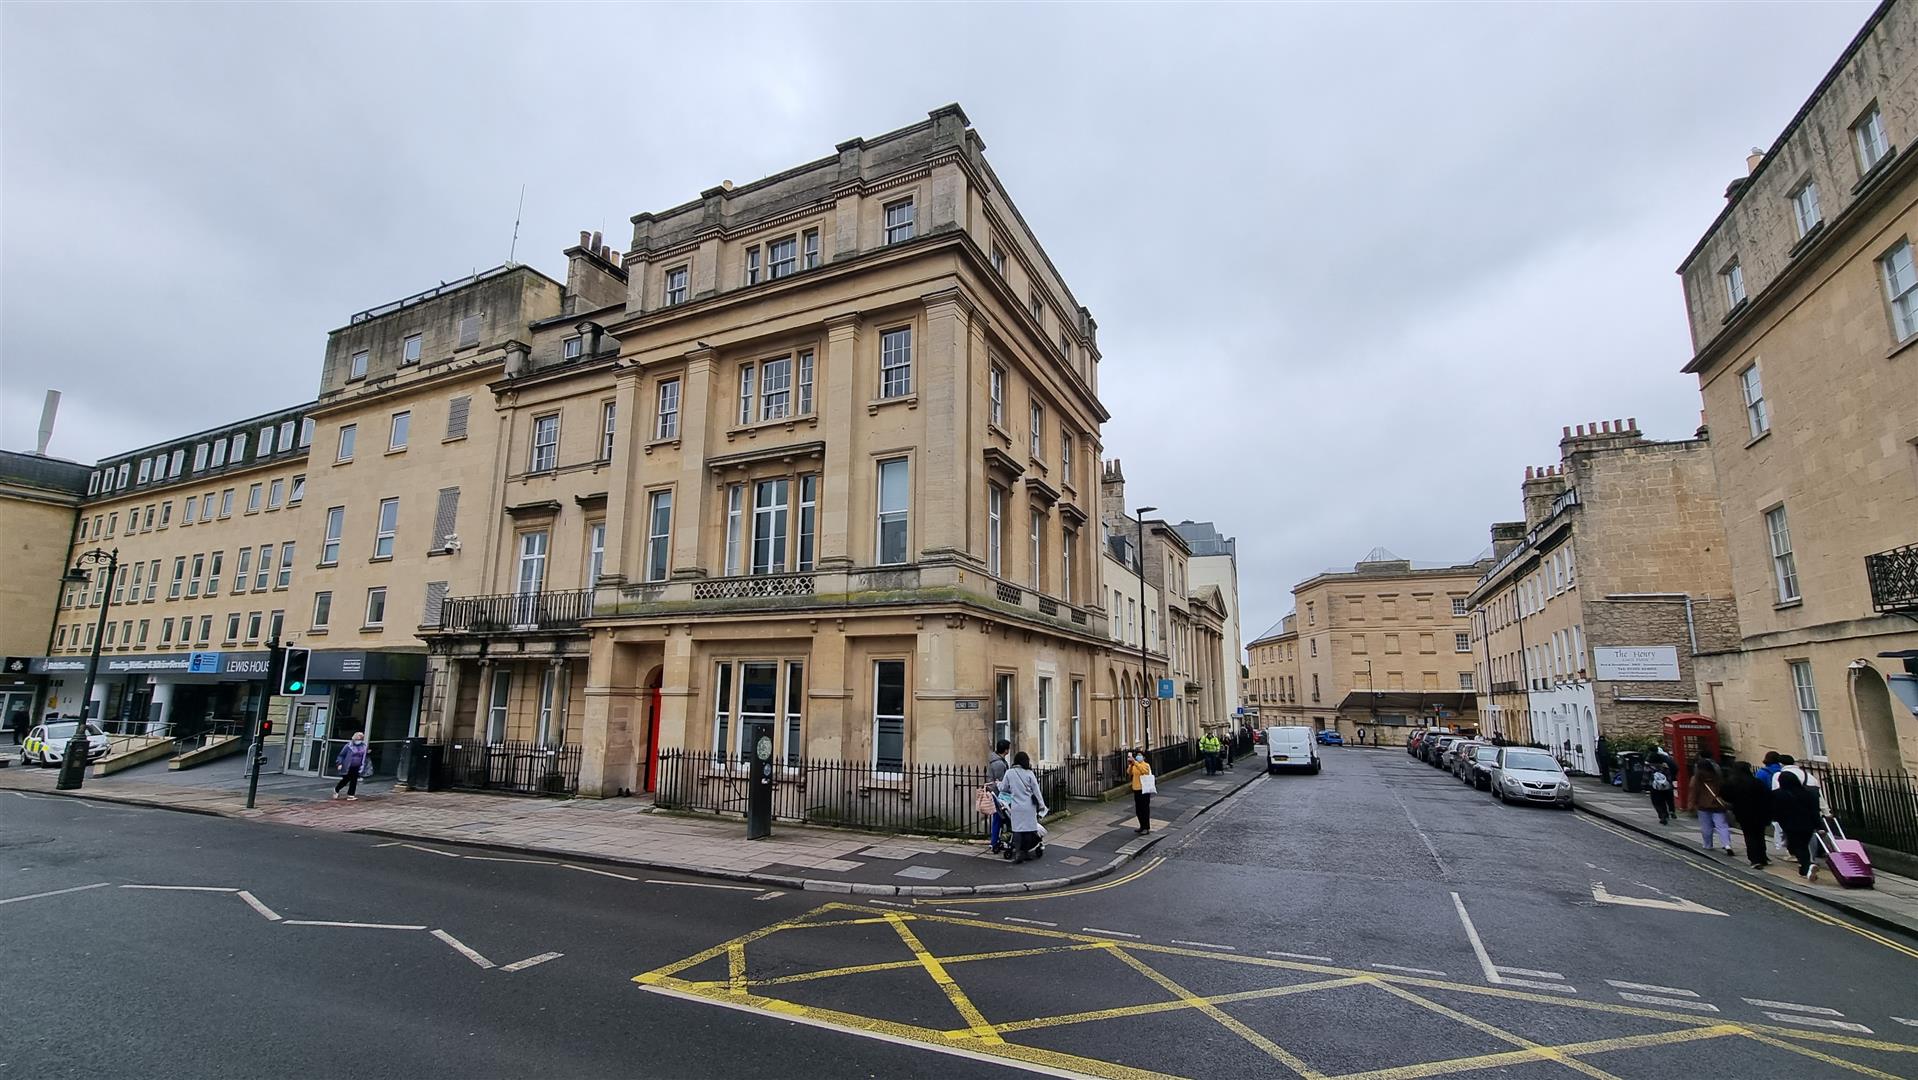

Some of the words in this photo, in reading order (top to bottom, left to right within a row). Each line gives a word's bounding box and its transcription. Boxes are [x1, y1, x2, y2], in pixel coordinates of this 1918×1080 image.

[1614, 650, 1628, 658] The
[226, 660, 250, 672] LEWIS
[249, 660, 270, 672] HOUS
